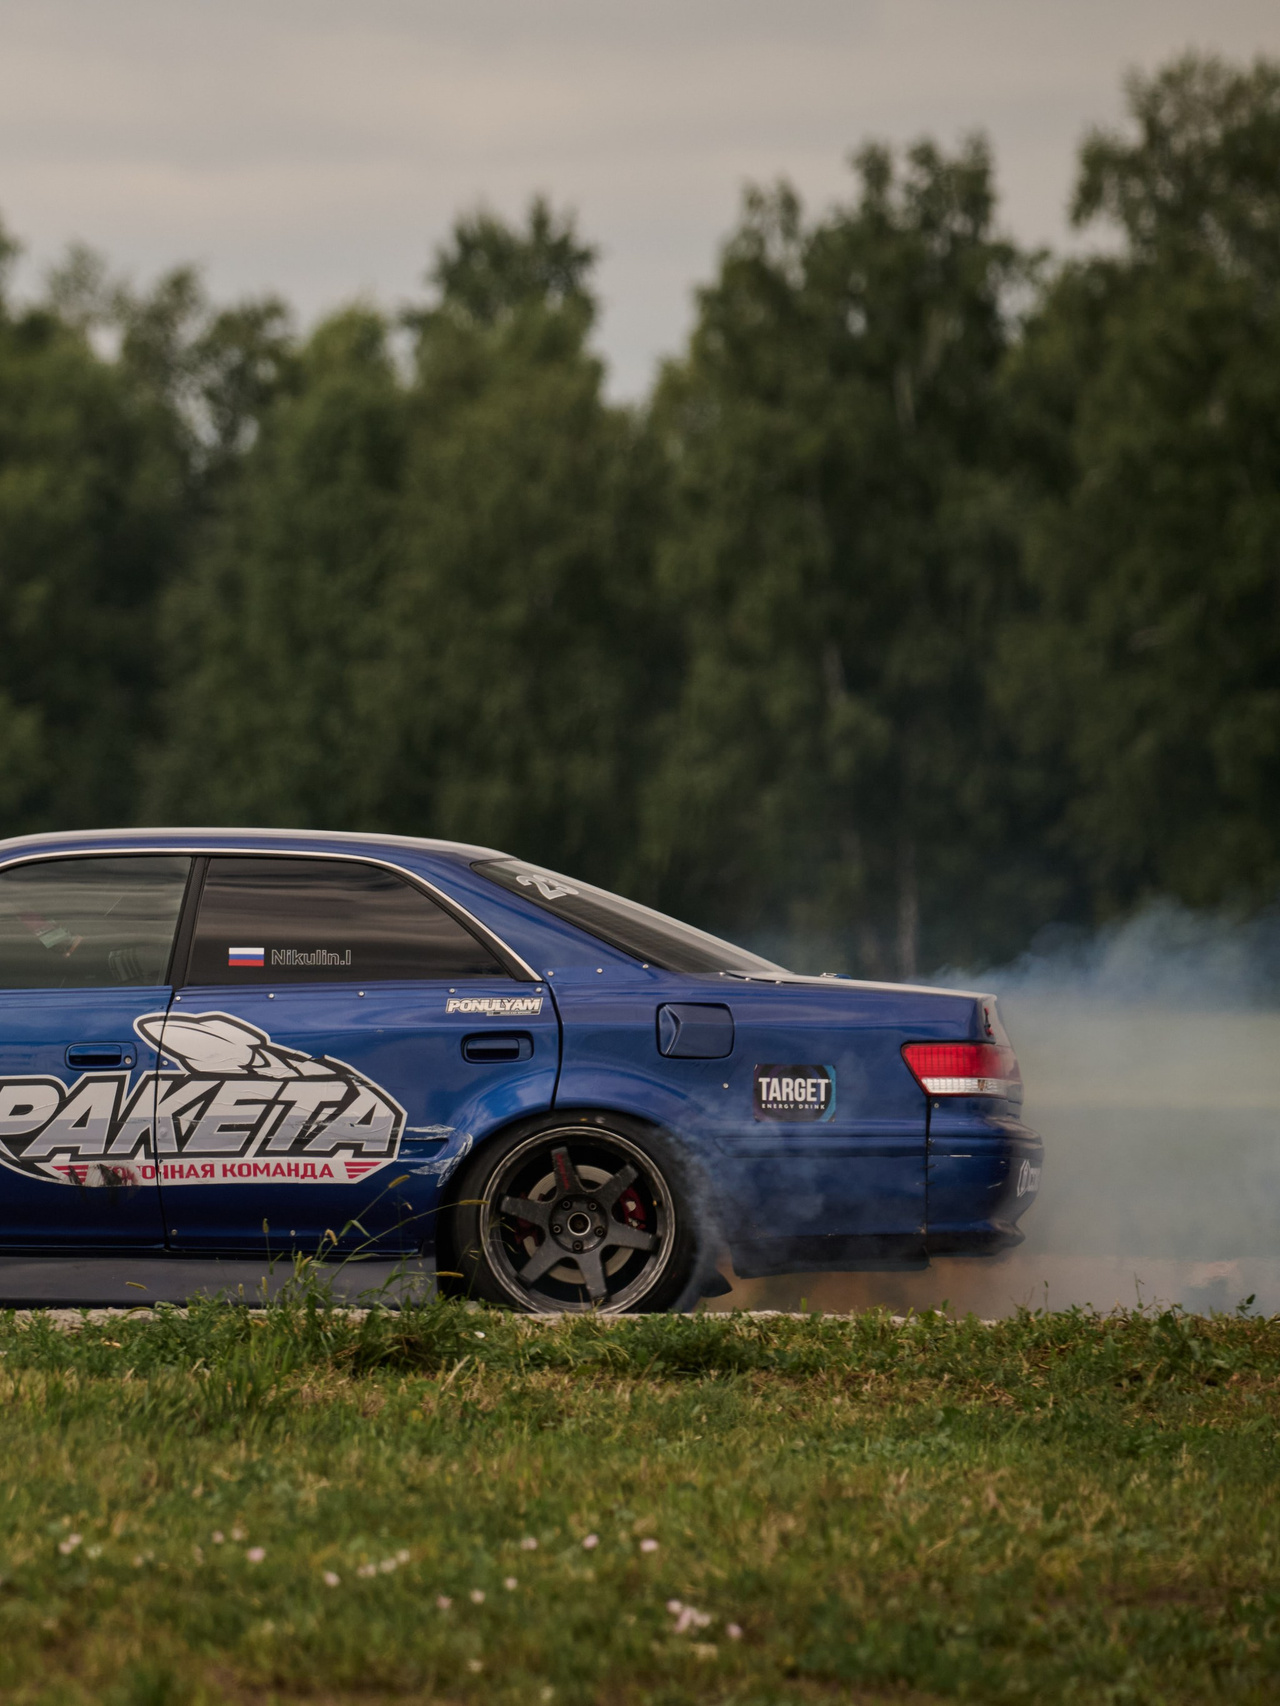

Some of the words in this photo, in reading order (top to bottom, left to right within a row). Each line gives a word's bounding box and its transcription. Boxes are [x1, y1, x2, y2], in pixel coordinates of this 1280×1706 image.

[447, 999, 542, 1012] PONULYAM
[758, 1077, 829, 1101] TARGET
[222, 1162, 335, 1180] КОМАНДА
